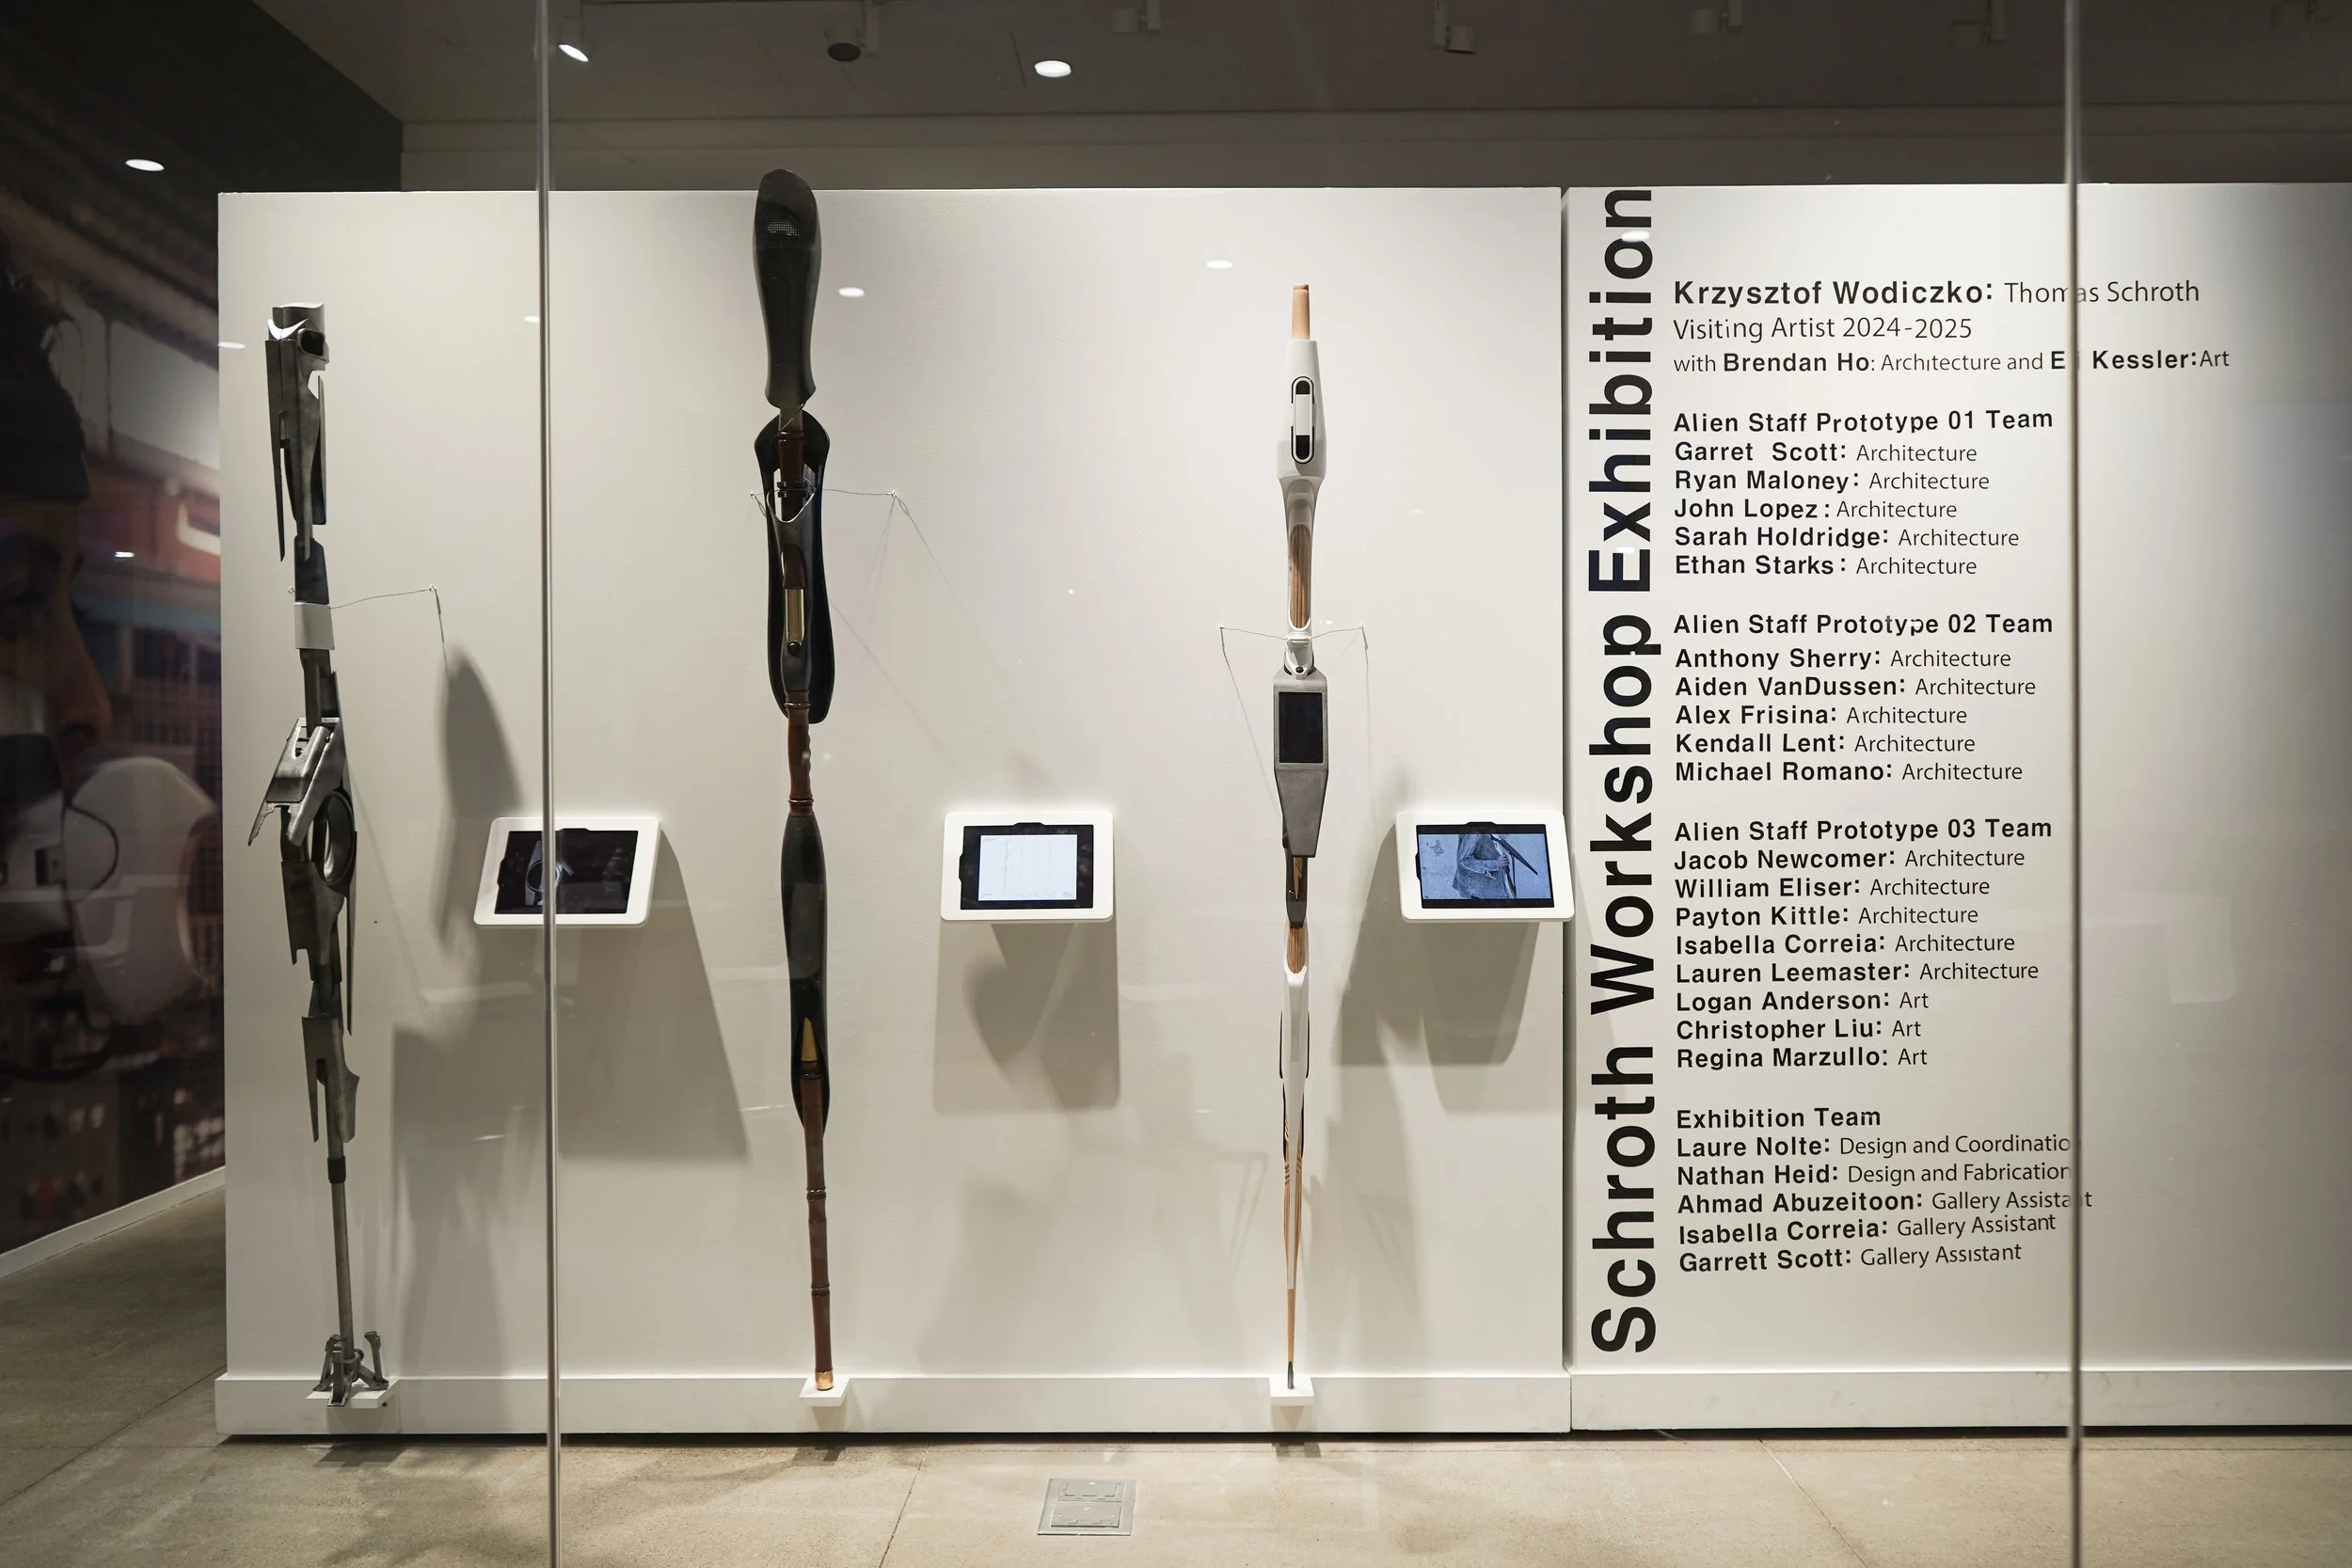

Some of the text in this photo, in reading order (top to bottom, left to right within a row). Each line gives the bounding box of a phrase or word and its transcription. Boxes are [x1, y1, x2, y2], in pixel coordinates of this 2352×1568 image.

[1675, 280, 1822, 309] Krzysztof
[1832, 279, 1993, 305] Wodiczko:
[2107, 280, 2200, 302] Schroth
[1673, 316, 1972, 344] Visiting Artist 2024-2025
[1673, 354, 1716, 372] with
[1724, 352, 1827, 372] Brendan
[1837, 352, 1875, 372] Ho:
[1881, 353, 2001, 372] Architecture
[2007, 352, 2043, 371] and
[1673, 409, 2053, 435] Alien Staff Prototype 01 Team
[1675, 440, 1978, 462] Garret Scott: Architecture
[1675, 469, 1990, 495] Ryan Maloney: Architecture
[1674, 498, 1734, 518] John
[1836, 499, 1958, 518] Architecture
[1675, 526, 2020, 549] Sarah Holdridge: Architecture
[1676, 554, 1745, 575] Ethan
[1855, 556, 1978, 575] Architecture
[1673, 613, 2053, 637] Alien Staff Prototype 02 Team
[1675, 647, 2011, 672] Anthony Sherry: Architecture
[1675, 675, 2036, 697] Aiden VanDussen: Architecture
[1675, 704, 1968, 725] Alex Frisina: Architecture
[1676, 732, 1976, 753] Kendall Lent: Architecture
[1588, 190, 1661, 1353] Schroth Workshop Exhibition
[1676, 761, 2023, 782] Michael Romano: Architecture
[1674, 817, 2052, 843] Alien Staff Prototype 03 Team
[1674, 848, 2026, 871] Jacob Newcomer: Architecture
[1674, 877, 1991, 899] William Eliser: Architecture
[1676, 905, 1979, 930] Payton Kittle: Architecture
[1677, 933, 2015, 956] Isabella Correia: Architecture
[1677, 961, 2039, 984] Lauren Leemaster: Architecture
[1677, 990, 1930, 1015] Logan Anderson: Art
[1676, 1018, 1922, 1042] Christopher Liu: Art
[1677, 1046, 1928, 1071] Regina Marzullo: Art
[1677, 1107, 1881, 1130] Exhibition Team
[1677, 1134, 2081, 1160] Laure Nolte: Design and Coordinatio
[1677, 1165, 1765, 1186] Nathan
[1774, 1164, 1838, 1184] Heid:
[1848, 1164, 1915, 1187] Design
[1920, 1163, 1958, 1182] and
[1677, 1191, 2092, 1214] Ahmad Abuzeitoon: Gallery Assistat
[1679, 1213, 2057, 1245] Isabella Correia: Gallery Assistant
[1678, 1243, 2023, 1273] Garrett Scott: Gallery Assistant
